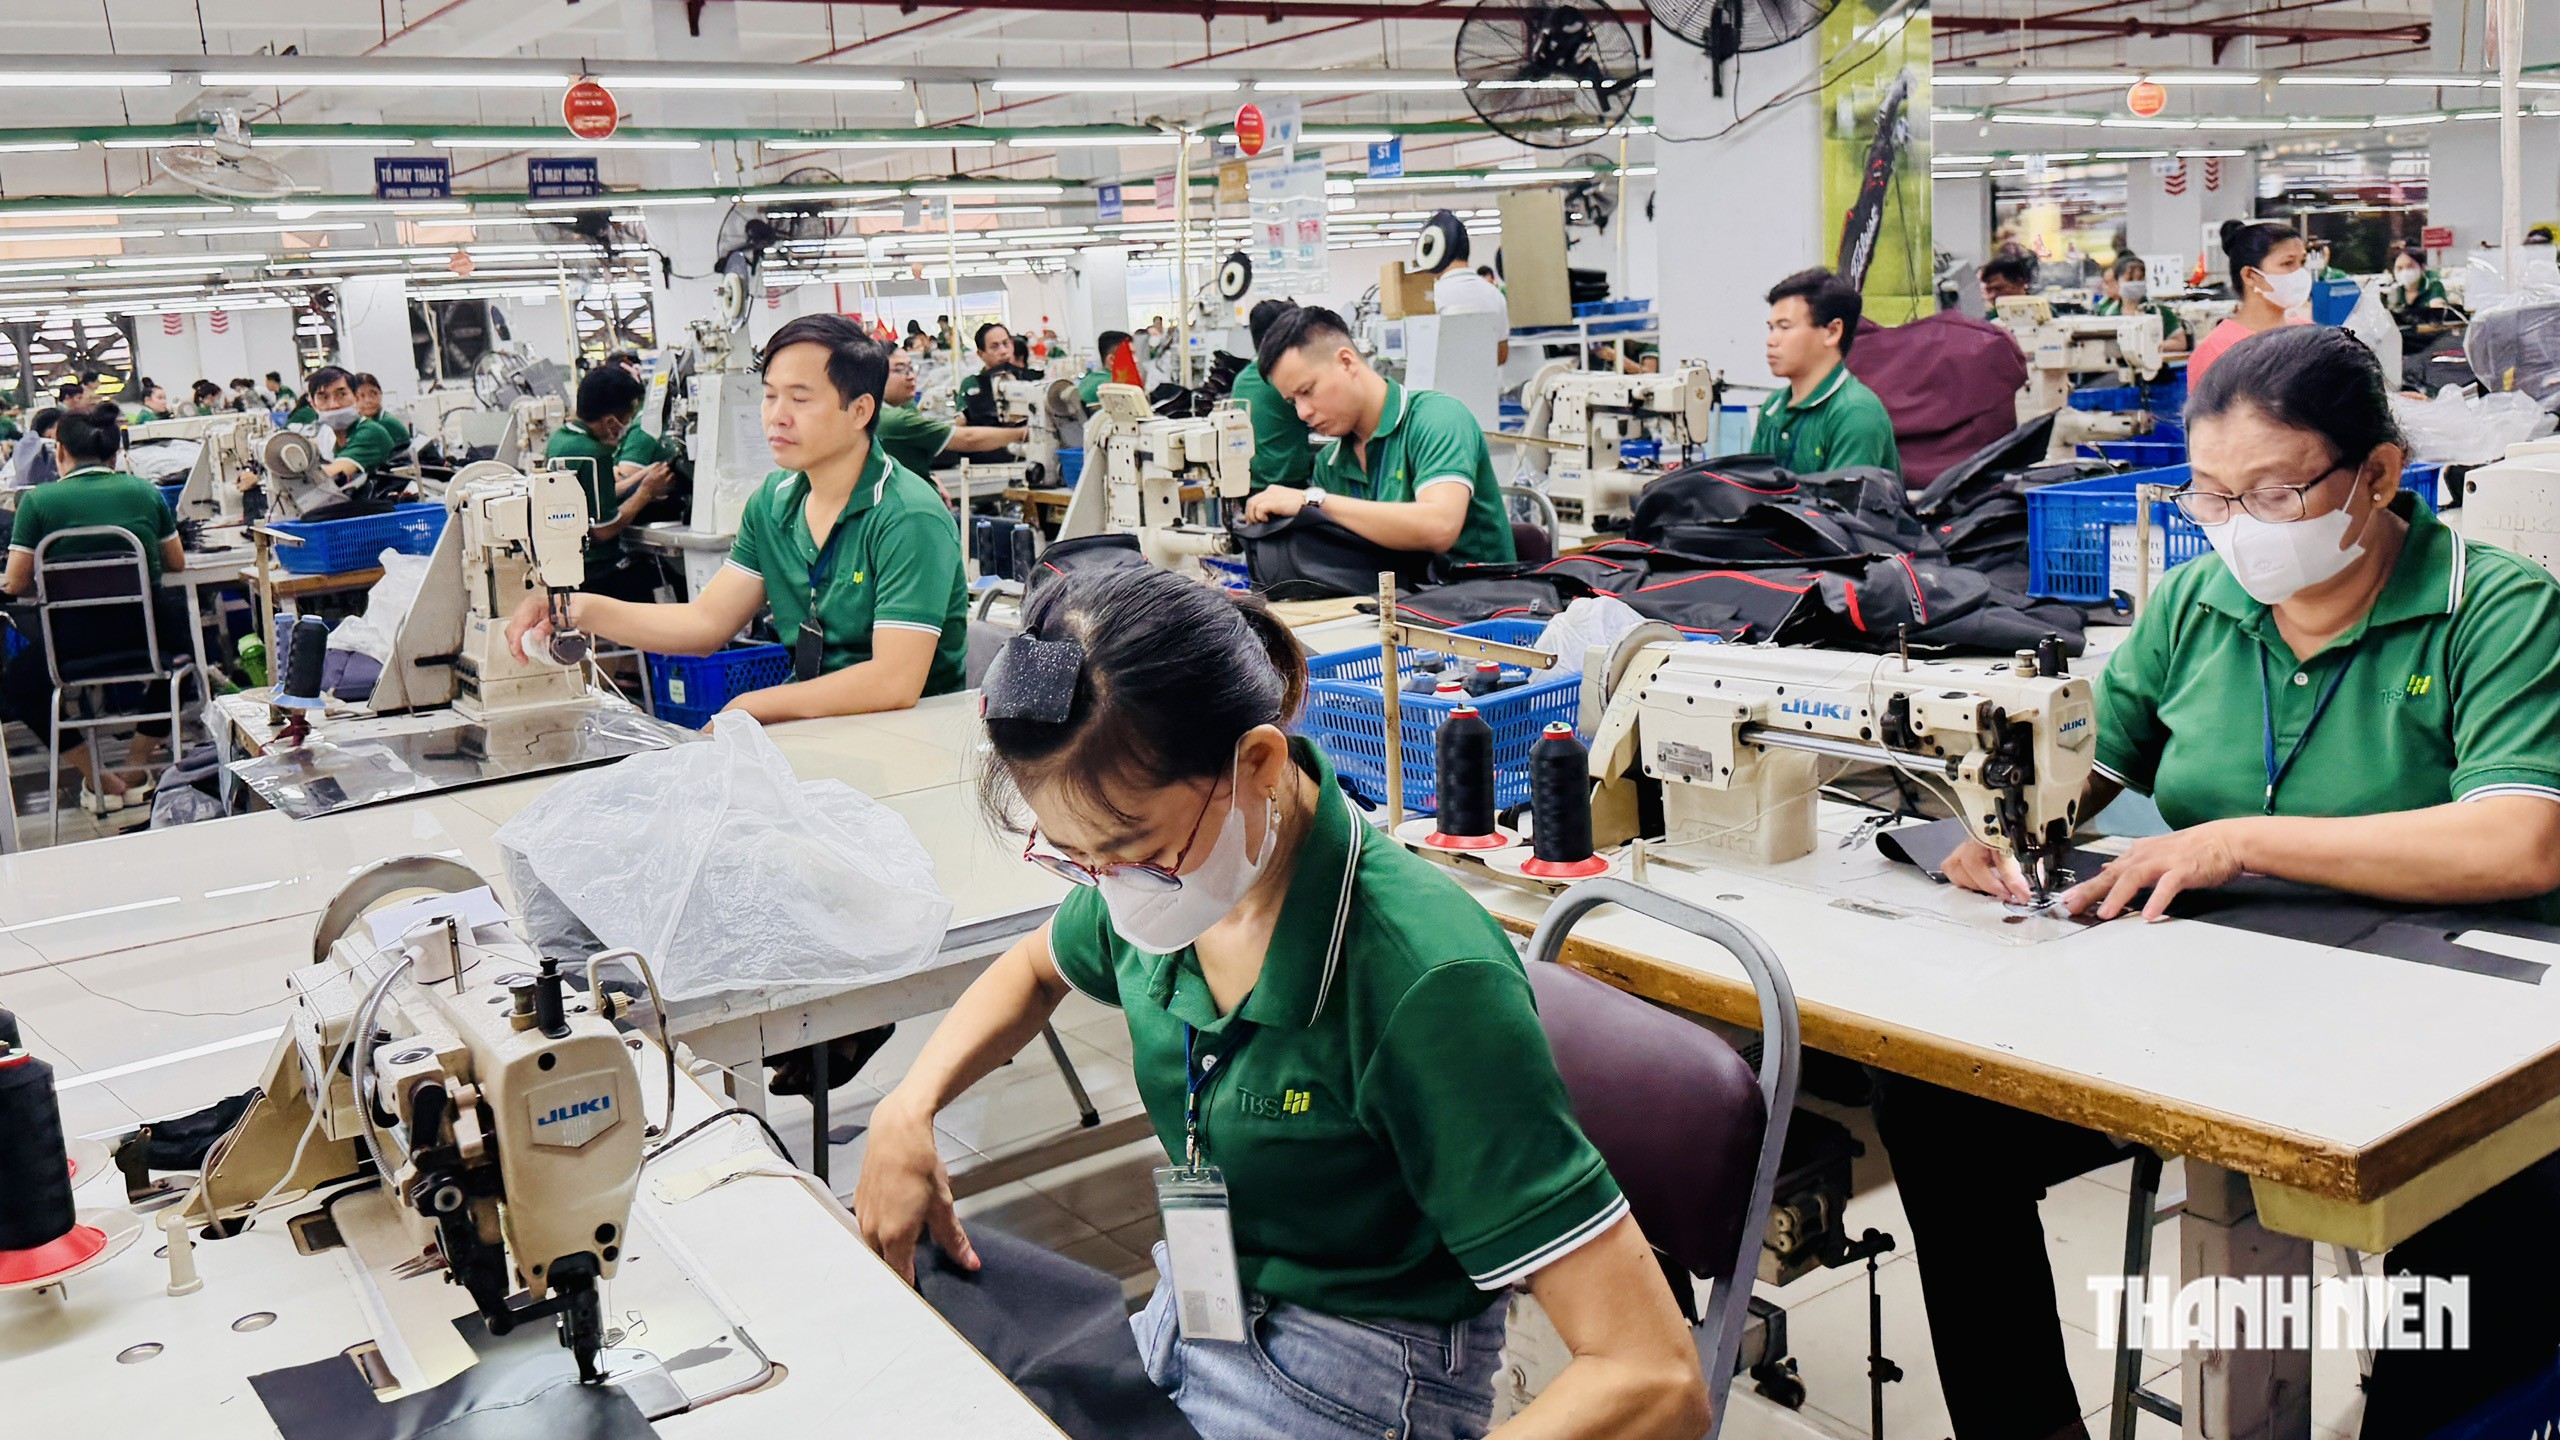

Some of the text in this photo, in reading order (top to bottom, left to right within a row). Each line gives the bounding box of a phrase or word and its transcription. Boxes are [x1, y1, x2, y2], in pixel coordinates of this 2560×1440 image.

[394, 168, 412, 182] MAY
[438, 168, 444, 183] 2
[545, 168, 562, 183] MAY
[588, 168, 595, 183] 2
[1781, 698, 1851, 721] JUKI
[2059, 717, 2087, 733] JUKI
[538, 1095, 610, 1126] JUKI
[1238, 1086, 1280, 1118] TBS
